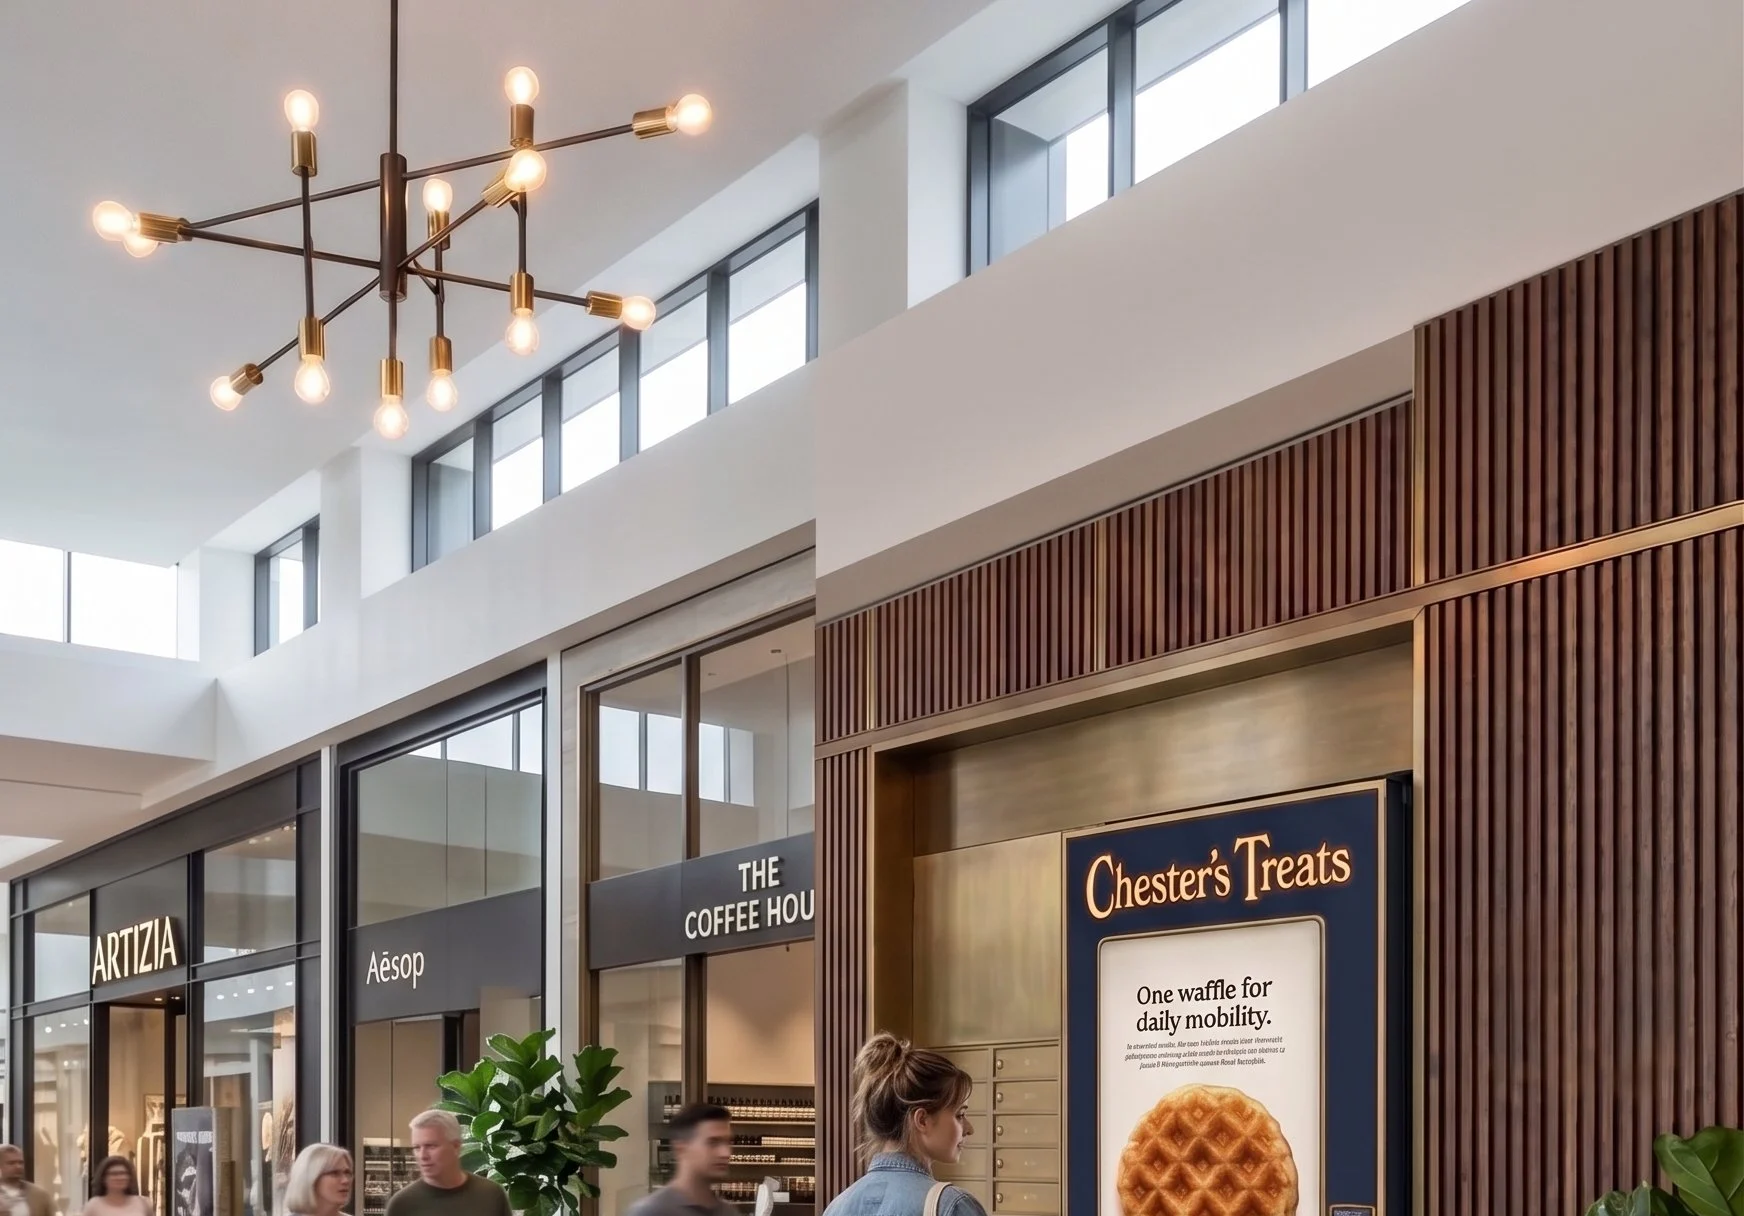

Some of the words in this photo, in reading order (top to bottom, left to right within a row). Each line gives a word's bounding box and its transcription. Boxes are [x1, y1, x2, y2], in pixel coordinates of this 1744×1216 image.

[738, 856, 780, 892] THE
[1086, 848, 1231, 919] Chester's
[1233, 833, 1351, 901] Treats
[685, 899, 760, 939] COFFEE
[767, 889, 815, 927] HOU
[92, 915, 177, 985] ARTIZIA
[1136, 986, 1174, 1005] One
[1177, 978, 1237, 1002] waffle
[1241, 976, 1273, 998] for
[1136, 1010, 1182, 1036] daily
[1185, 1004, 1272, 1031] mobility.
